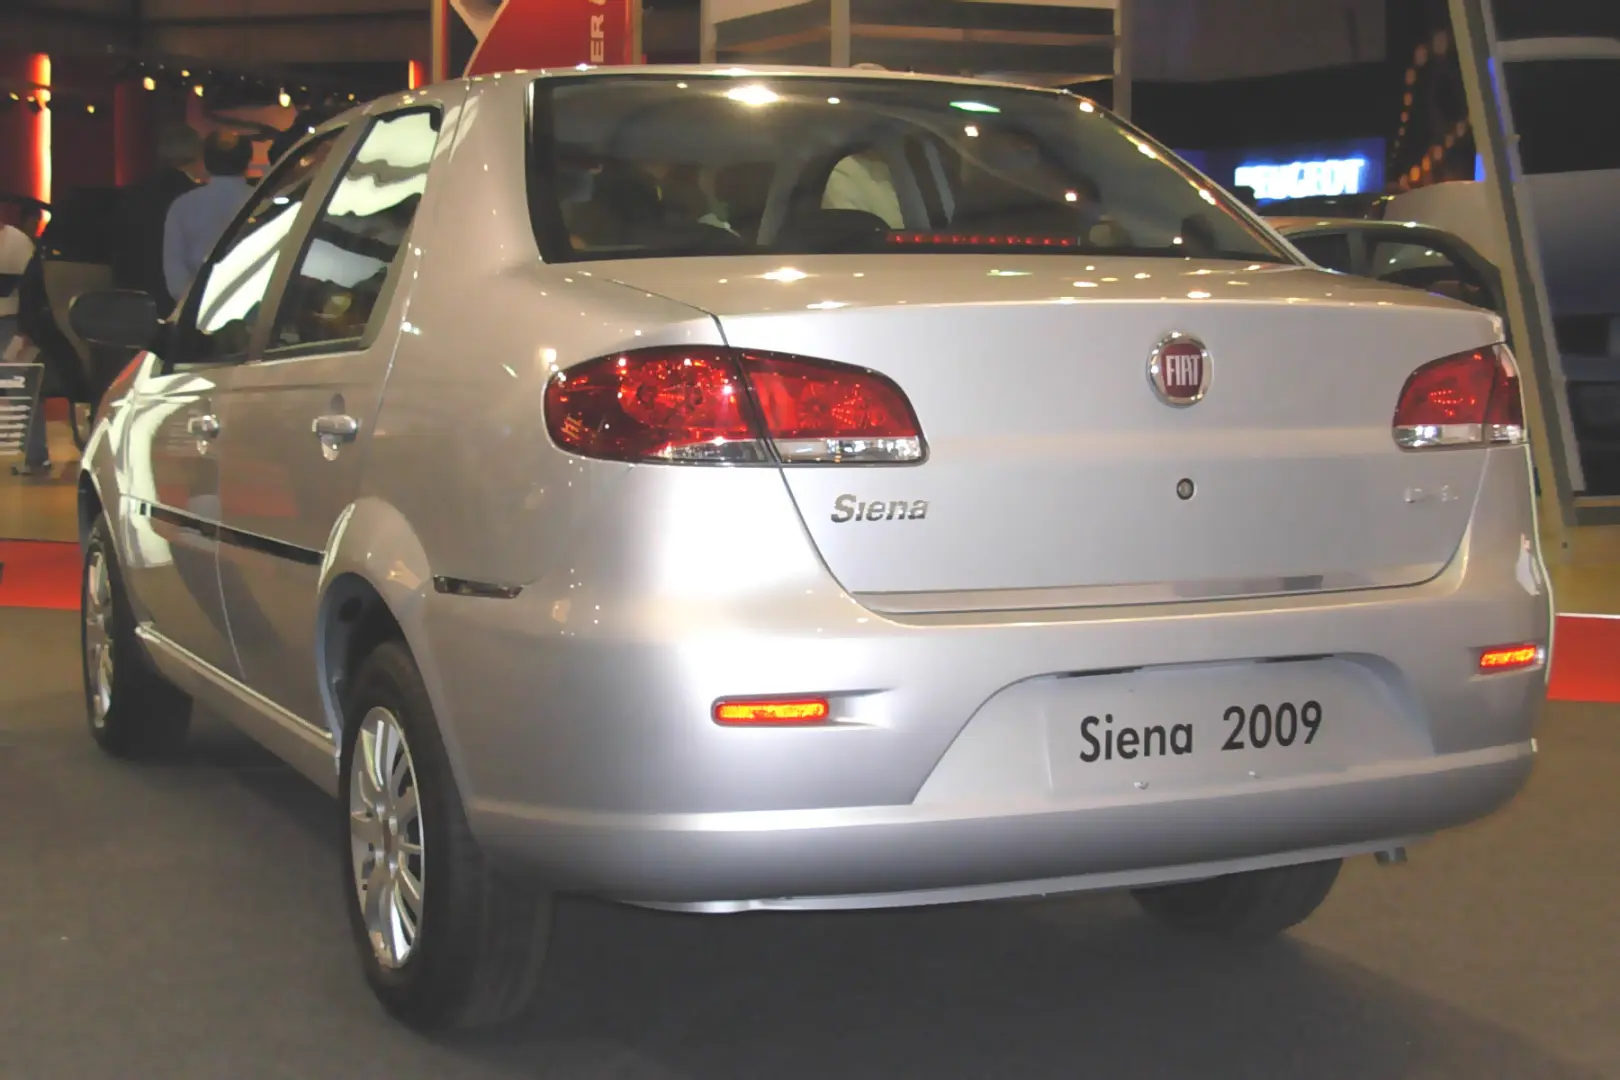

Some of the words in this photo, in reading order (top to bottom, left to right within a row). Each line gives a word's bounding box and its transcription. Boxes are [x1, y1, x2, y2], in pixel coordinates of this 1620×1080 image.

[1166, 354, 1200, 386] FIAT
[830, 494, 929, 523] Siena
[1079, 713, 1193, 763] Siena
[1220, 700, 1322, 751] 2009
